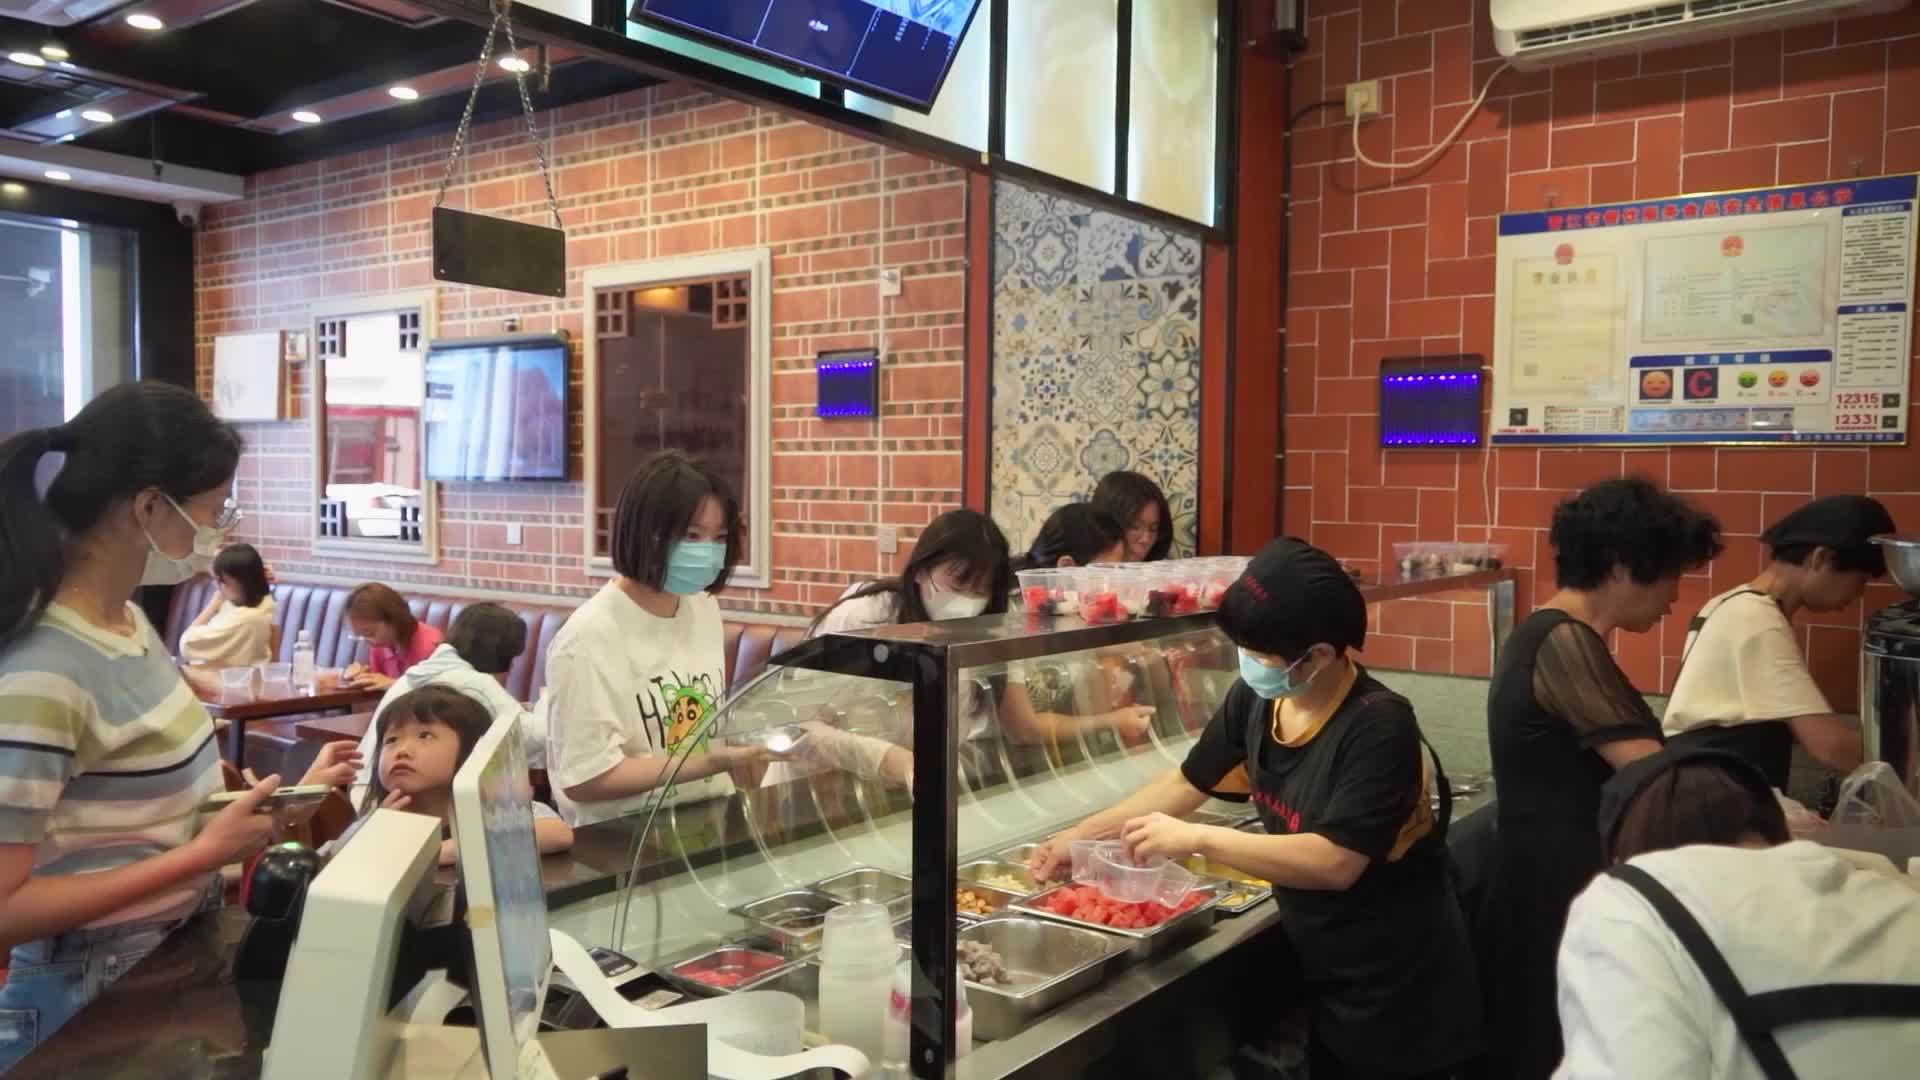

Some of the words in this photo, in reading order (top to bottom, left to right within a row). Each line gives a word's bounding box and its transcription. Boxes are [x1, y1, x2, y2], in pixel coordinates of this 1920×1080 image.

[1688, 370, 1713, 397] C
[1836, 392, 1879, 405] 12315
[1835, 413, 1878, 425] 12331
